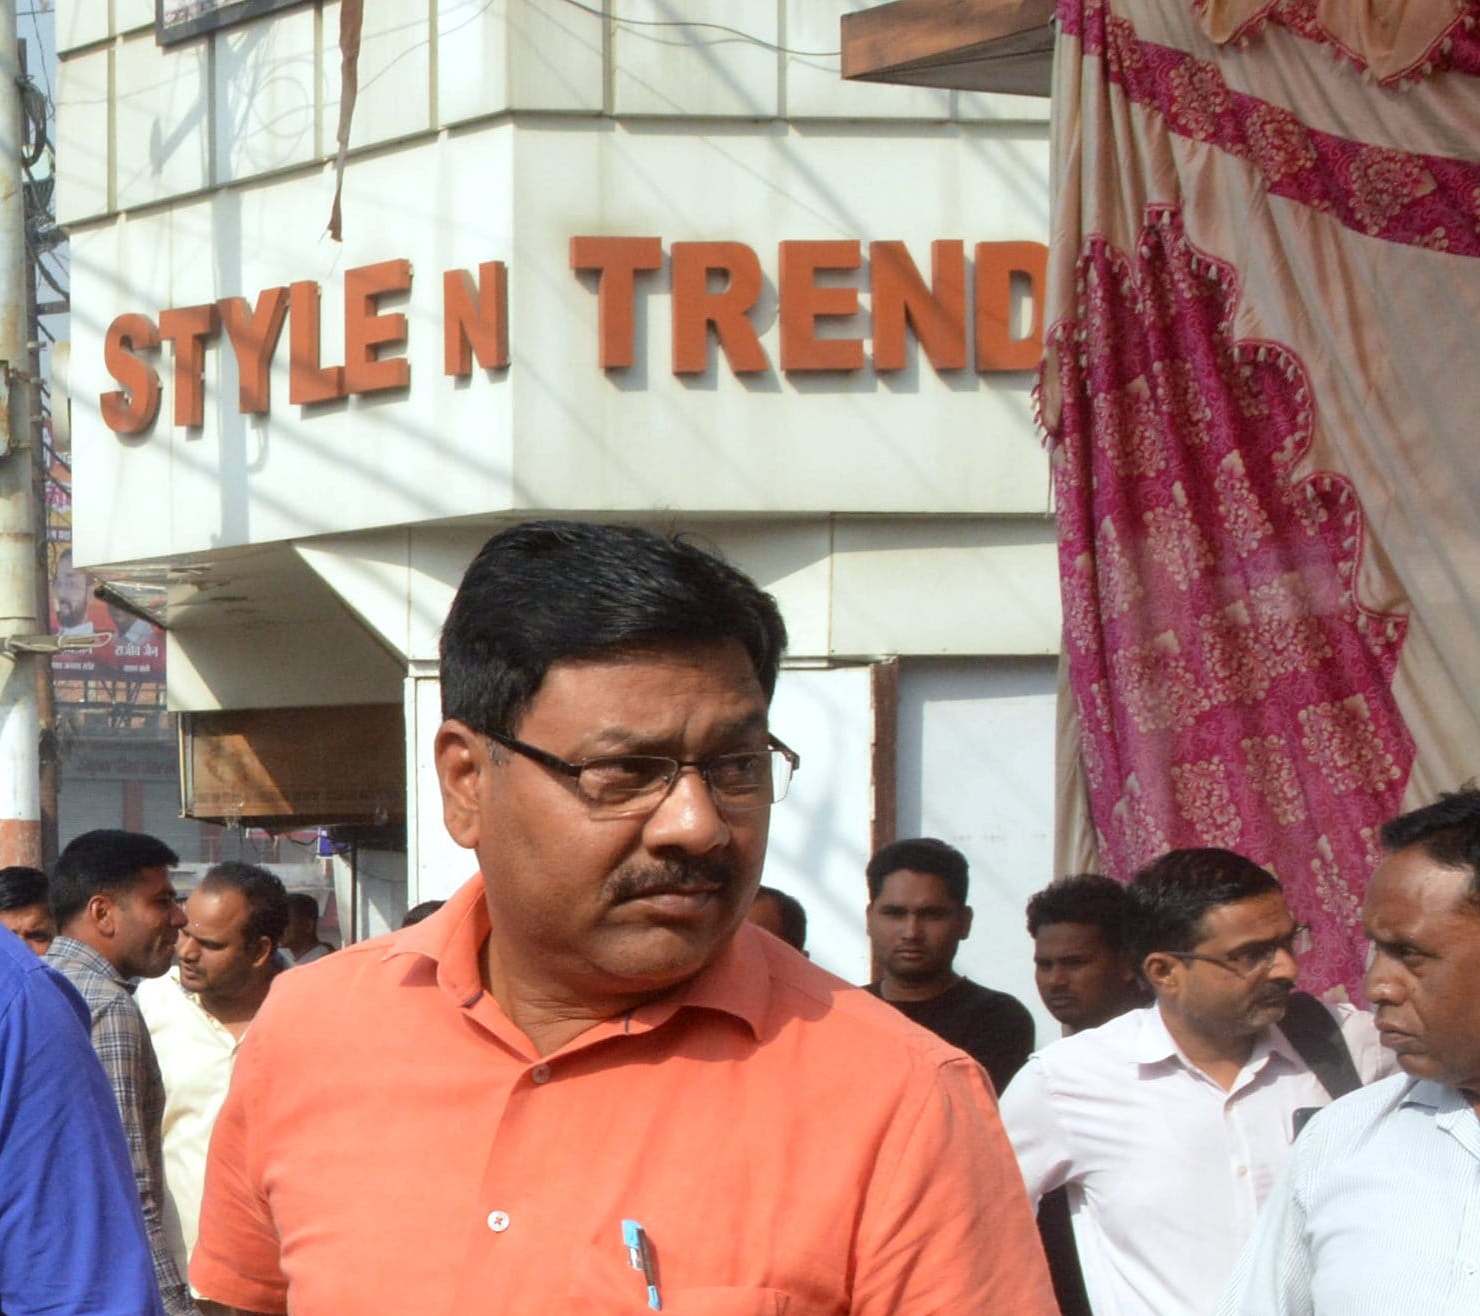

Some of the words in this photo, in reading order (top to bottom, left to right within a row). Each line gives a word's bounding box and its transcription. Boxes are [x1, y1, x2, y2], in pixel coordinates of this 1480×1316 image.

[100, 258, 413, 434] STYLE
[444, 260, 510, 377] N
[569, 236, 1049, 374] TREND
